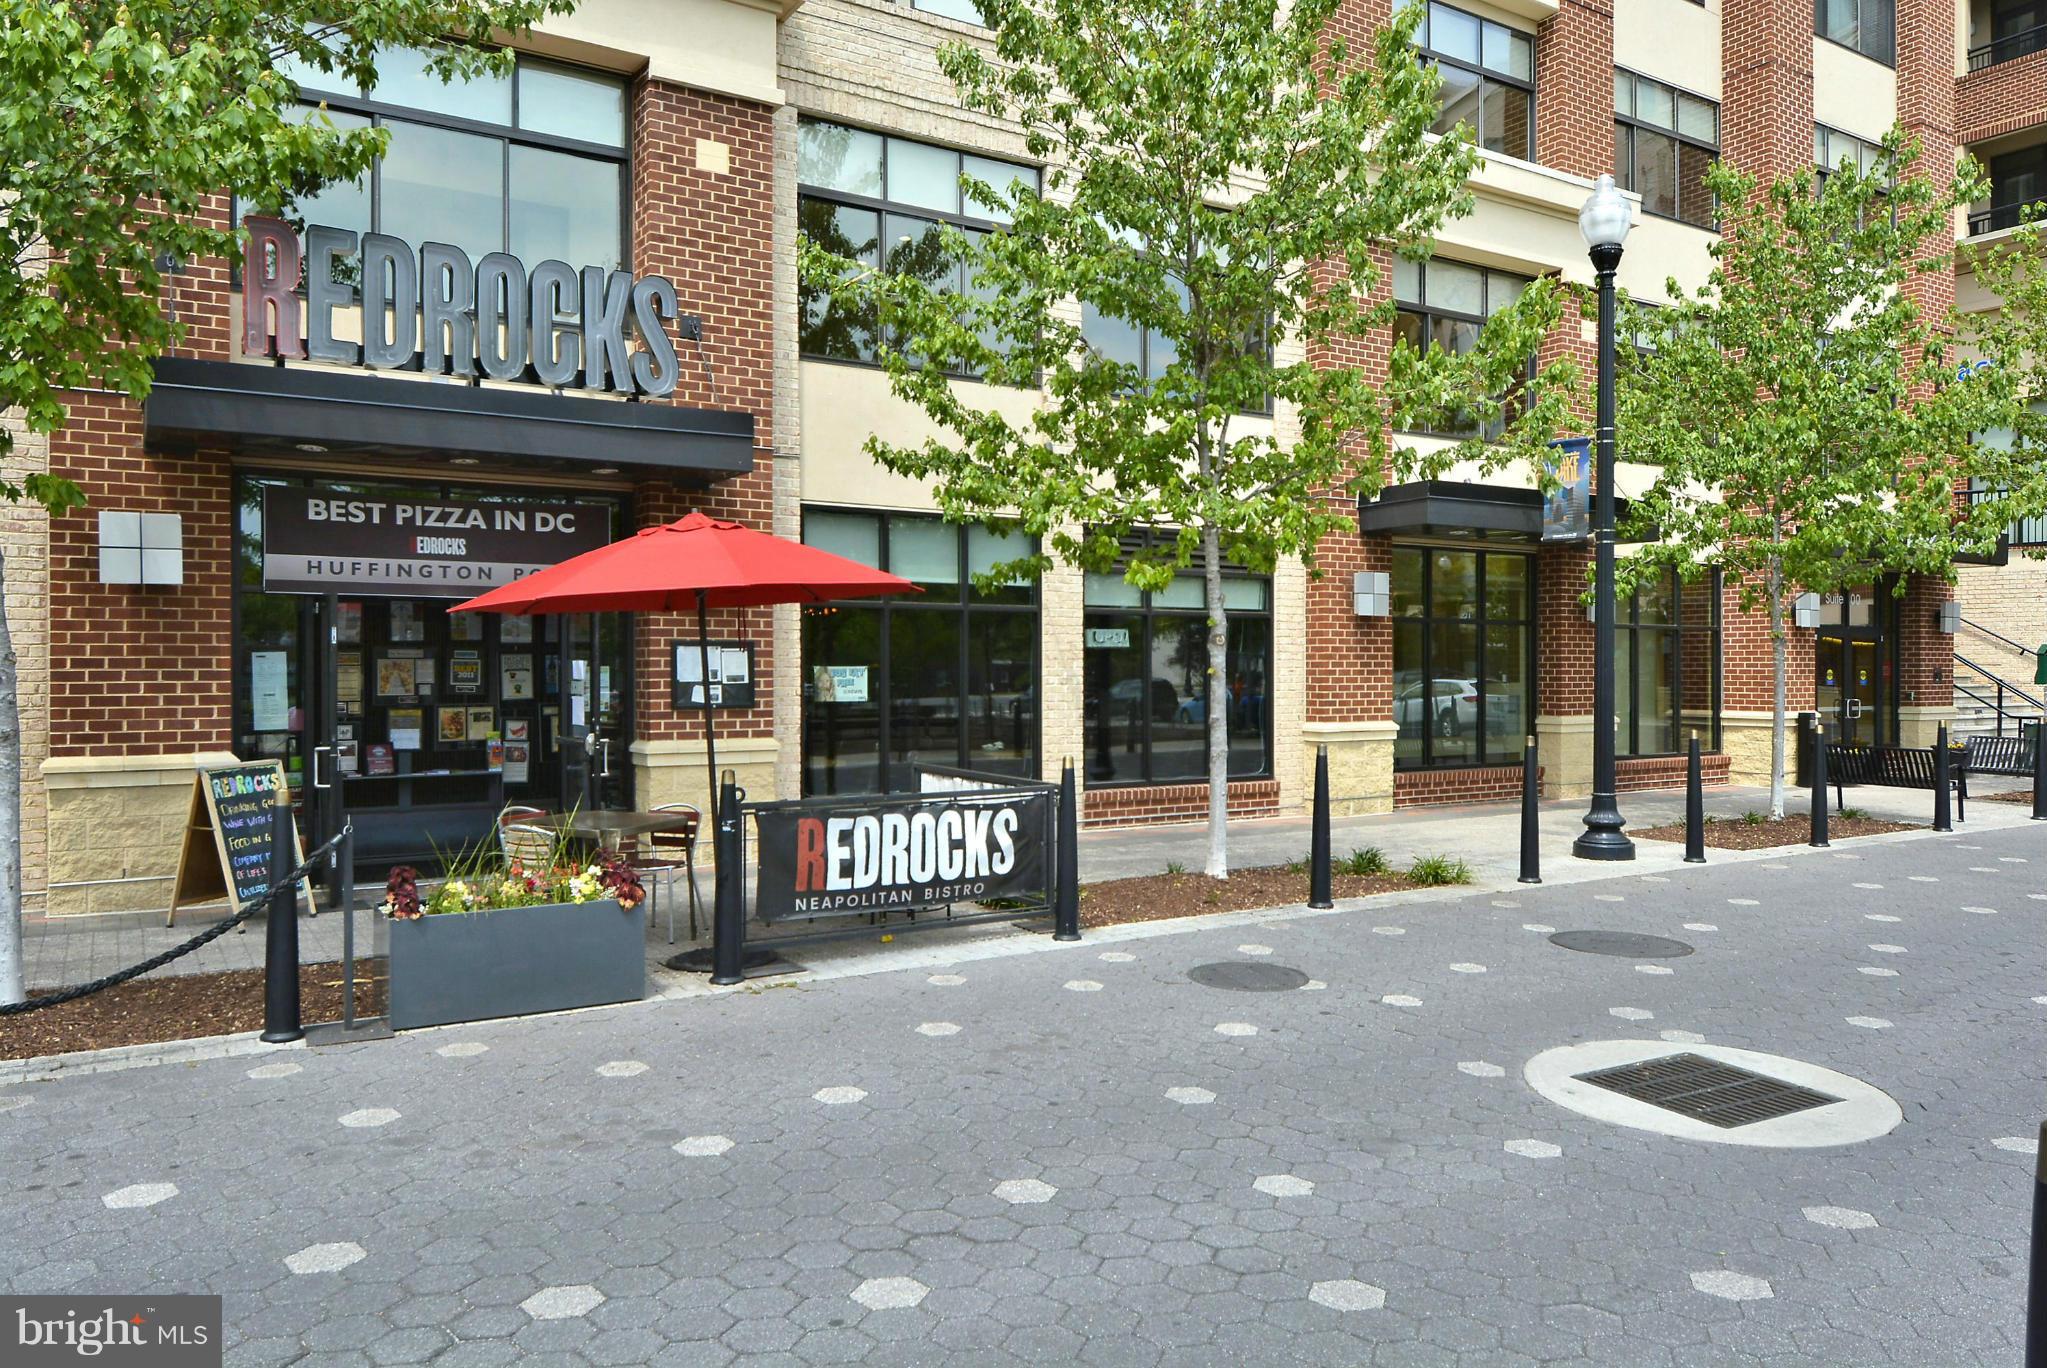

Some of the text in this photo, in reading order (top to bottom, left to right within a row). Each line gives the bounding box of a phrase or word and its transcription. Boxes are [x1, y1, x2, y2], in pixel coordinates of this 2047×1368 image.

[242, 214, 679, 397] REDROCKS
[308, 498, 575, 534] BEST PIZZA IN DC
[307, 560, 541, 581] HUFFINGTON P
[1825, 592, 1844, 605] Suite
[212, 772, 281, 799] REDROCKS
[795, 808, 1018, 892] REDROCKS
[795, 882, 985, 912] NEAPOLITAN BISTRO
